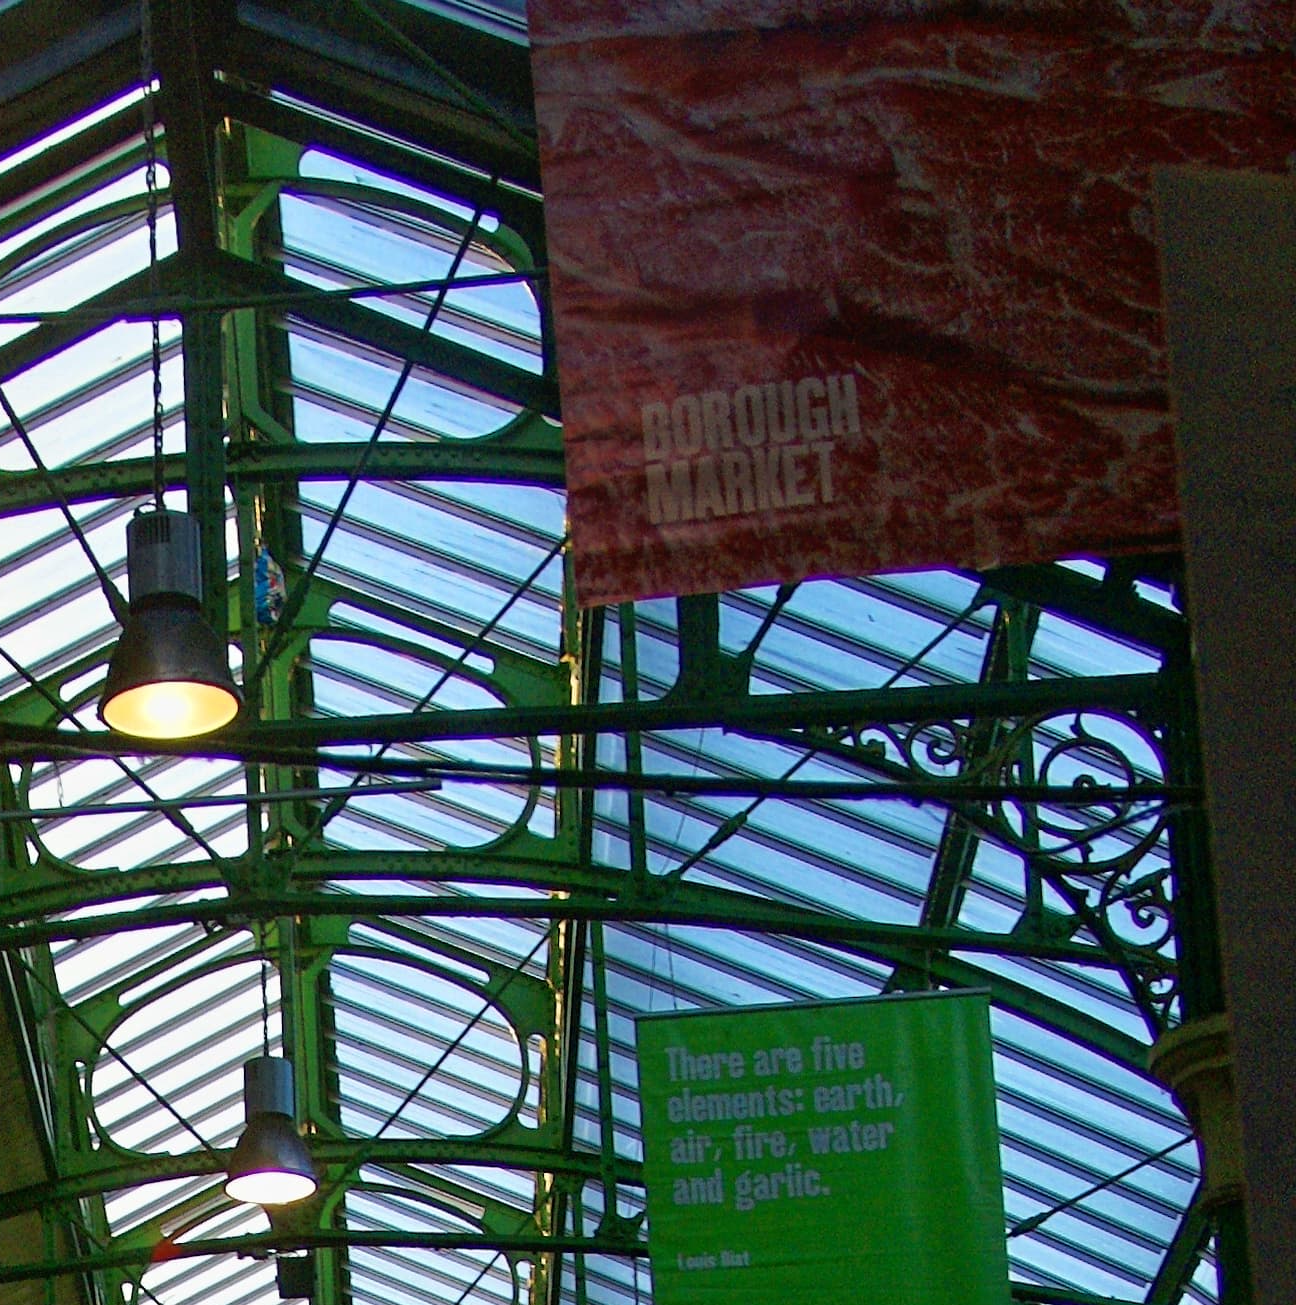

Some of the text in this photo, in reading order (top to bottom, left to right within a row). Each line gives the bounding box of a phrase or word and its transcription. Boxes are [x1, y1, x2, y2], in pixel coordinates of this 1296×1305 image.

[642, 374, 861, 459] BOROUGH
[645, 441, 835, 525] MARKET
[665, 1036, 865, 1082] There are five
[667, 1073, 905, 1122] elements: earth,
[670, 1120, 893, 1163] air, fire, water
[673, 1164, 831, 1211] and garlic.
